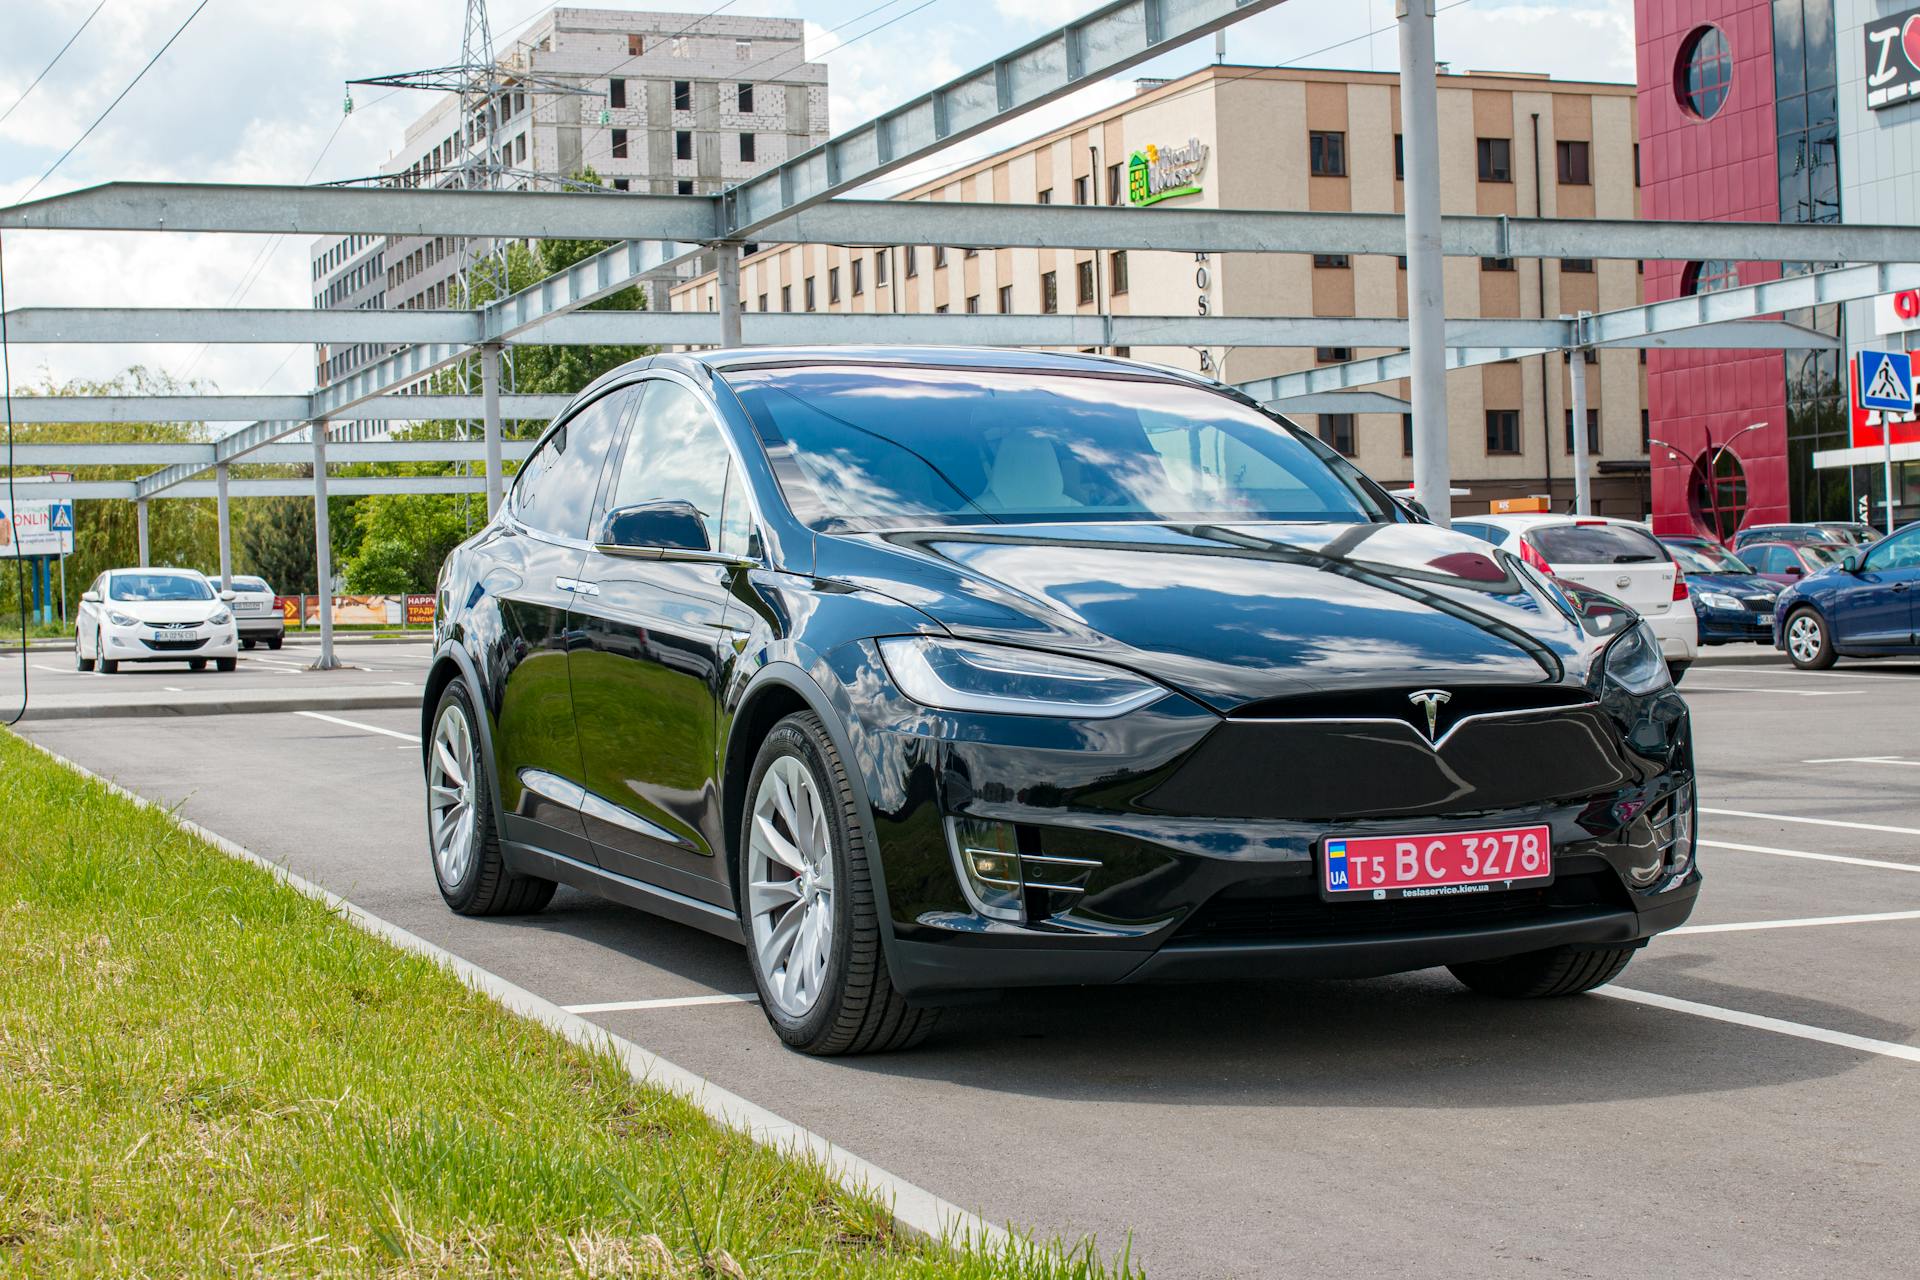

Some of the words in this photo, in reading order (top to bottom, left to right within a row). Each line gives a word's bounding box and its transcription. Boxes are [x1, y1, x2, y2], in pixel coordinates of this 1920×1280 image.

[1350, 856, 1386, 884] T5
[1395, 840, 1447, 882] BC
[1461, 833, 1540, 877] 3278
[1330, 871, 1348, 885] UA
[1402, 883, 1489, 898] teslaservice.kiev.ua
